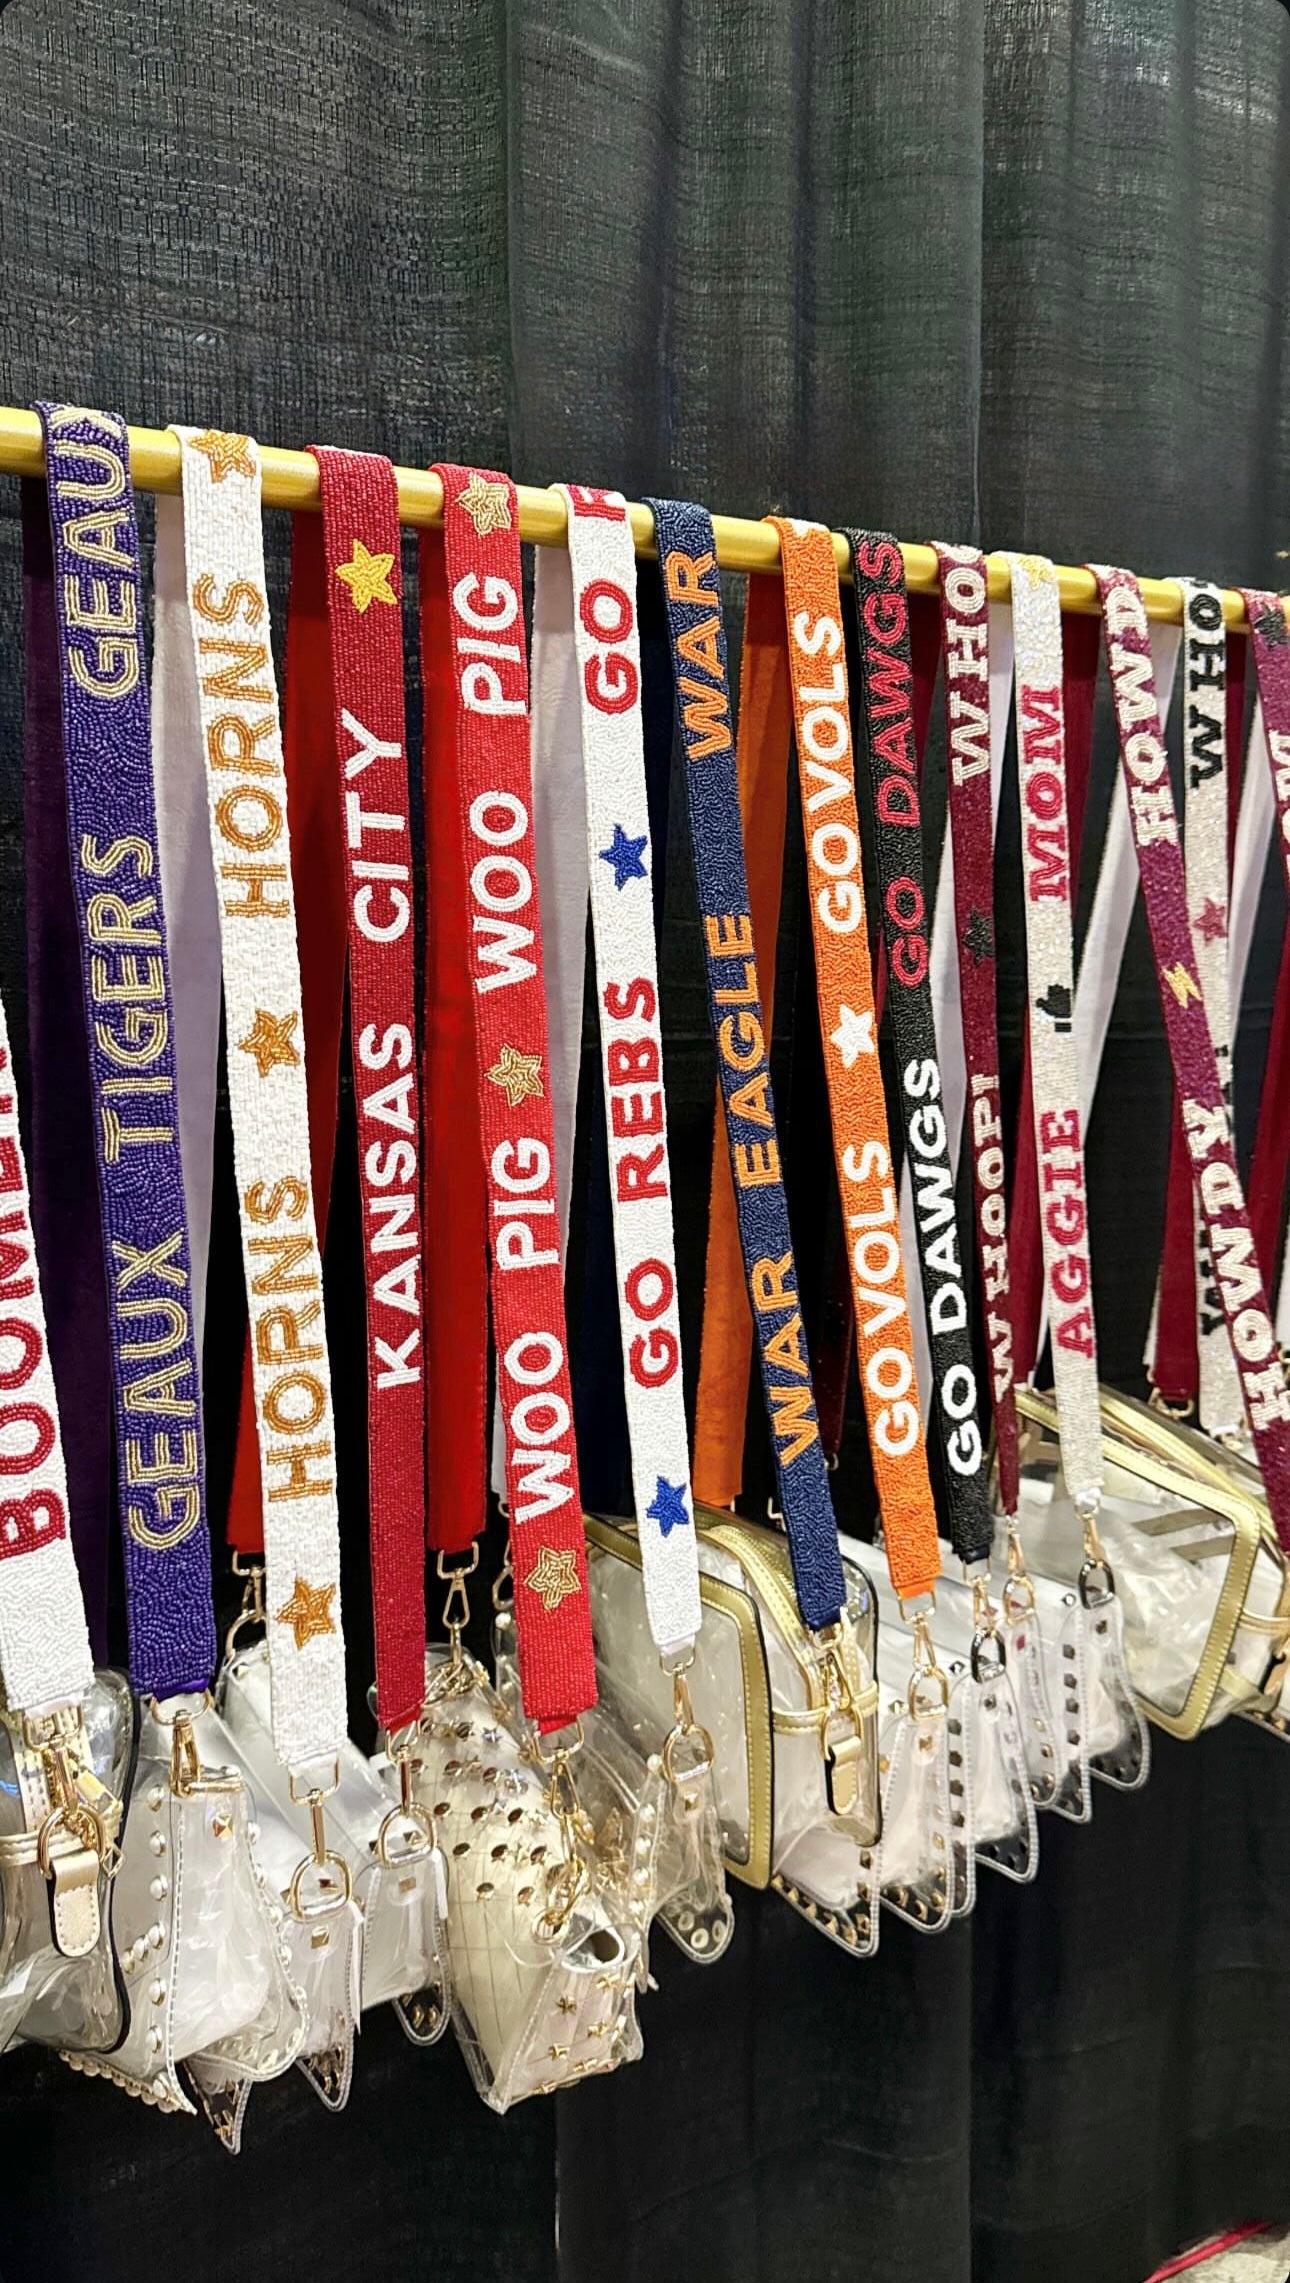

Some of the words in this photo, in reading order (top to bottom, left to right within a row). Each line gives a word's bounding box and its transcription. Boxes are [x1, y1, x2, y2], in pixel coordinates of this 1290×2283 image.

[193, 573, 288, 918] HORNS
[453, 572, 528, 717] PIG
[579, 578, 638, 714] GO
[665, 550, 732, 761] WAR
[858, 541, 921, 828] DAWGS
[341, 708, 411, 943] CITY
[470, 791, 537, 995] WOO
[1021, 685, 1071, 903] MOM
[81, 834, 174, 1164] TIGERS
[887, 876, 929, 987] GO
[604, 977, 668, 1202] REBS
[705, 913, 782, 1188] EAGLE
[359, 1023, 422, 1390] KANSAS
[491, 1137, 560, 1271] PIG
[904, 1058, 968, 1335] DAWGS
[1040, 1108, 1094, 1359] AGGIE
[1182, 1098, 1290, 1431] HOWDY
[111, 1228, 200, 1551] GEAUX
[245, 1175, 333, 1502] HORNS
[504, 1331, 576, 1525] WOO
[625, 1258, 680, 1390] GO
[752, 1251, 819, 1468] WAR
[942, 1364, 983, 1477] GO
